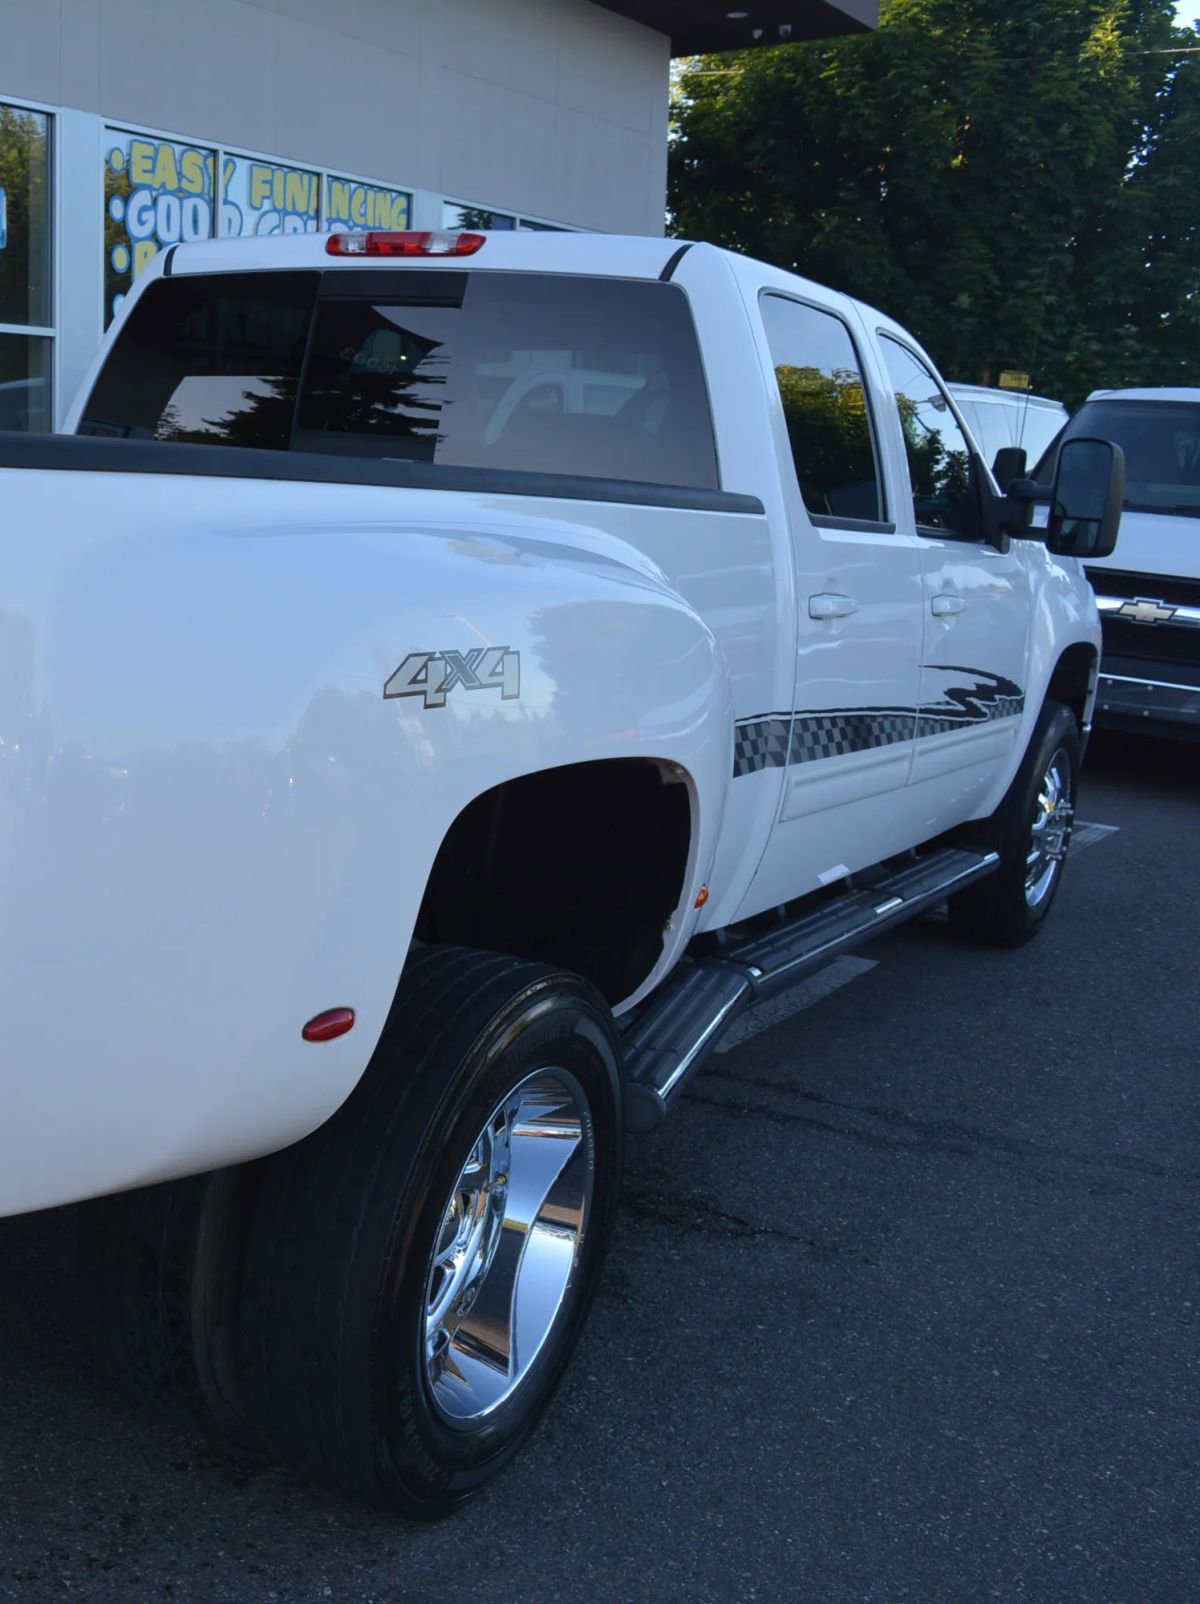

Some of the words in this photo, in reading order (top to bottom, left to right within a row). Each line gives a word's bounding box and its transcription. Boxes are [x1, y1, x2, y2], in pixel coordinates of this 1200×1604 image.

[129, 139, 237, 203] EASY
[127, 188, 243, 243] GOOD
[383, 646, 520, 709] 4X4
